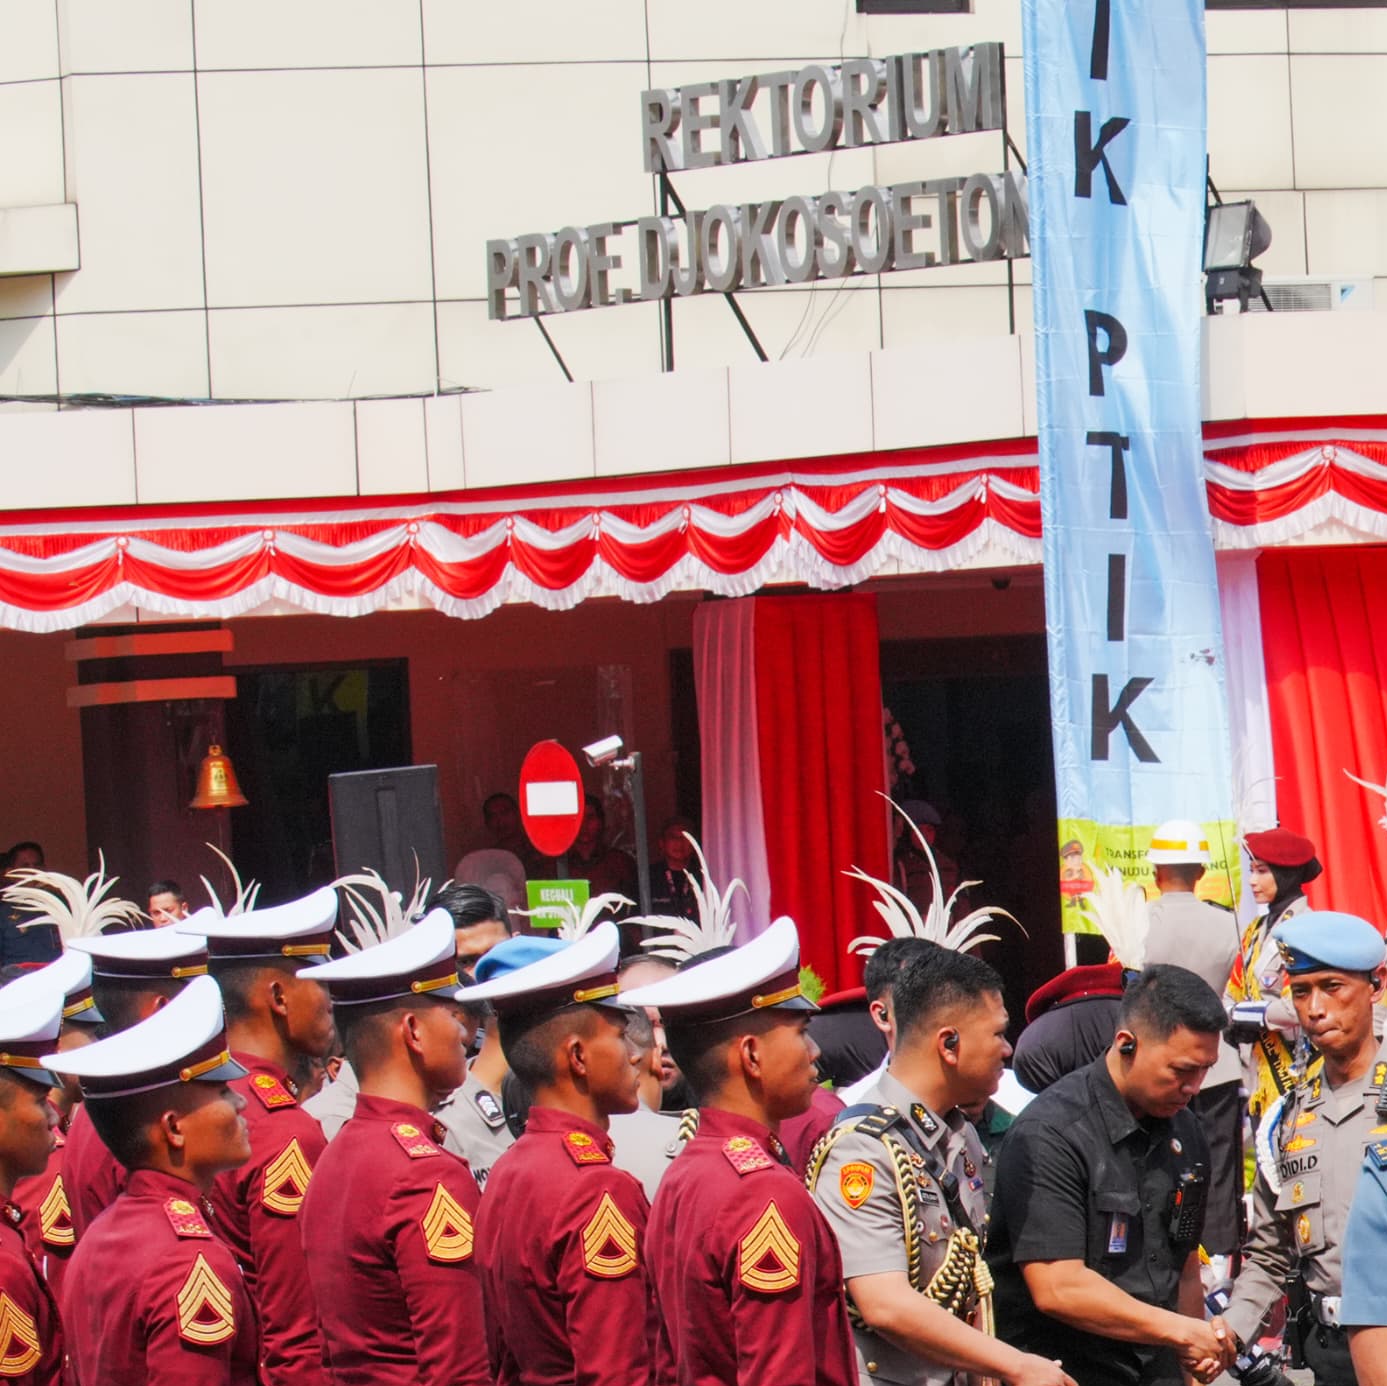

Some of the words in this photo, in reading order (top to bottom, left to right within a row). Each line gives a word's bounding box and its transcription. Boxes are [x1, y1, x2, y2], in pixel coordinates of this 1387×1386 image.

[641, 42, 1006, 174] REKTORIUM
[486, 225, 633, 321] PROF.
[1086, 310, 1162, 764] PTIK
[1280, 1154, 1319, 1179] DIDI.D
